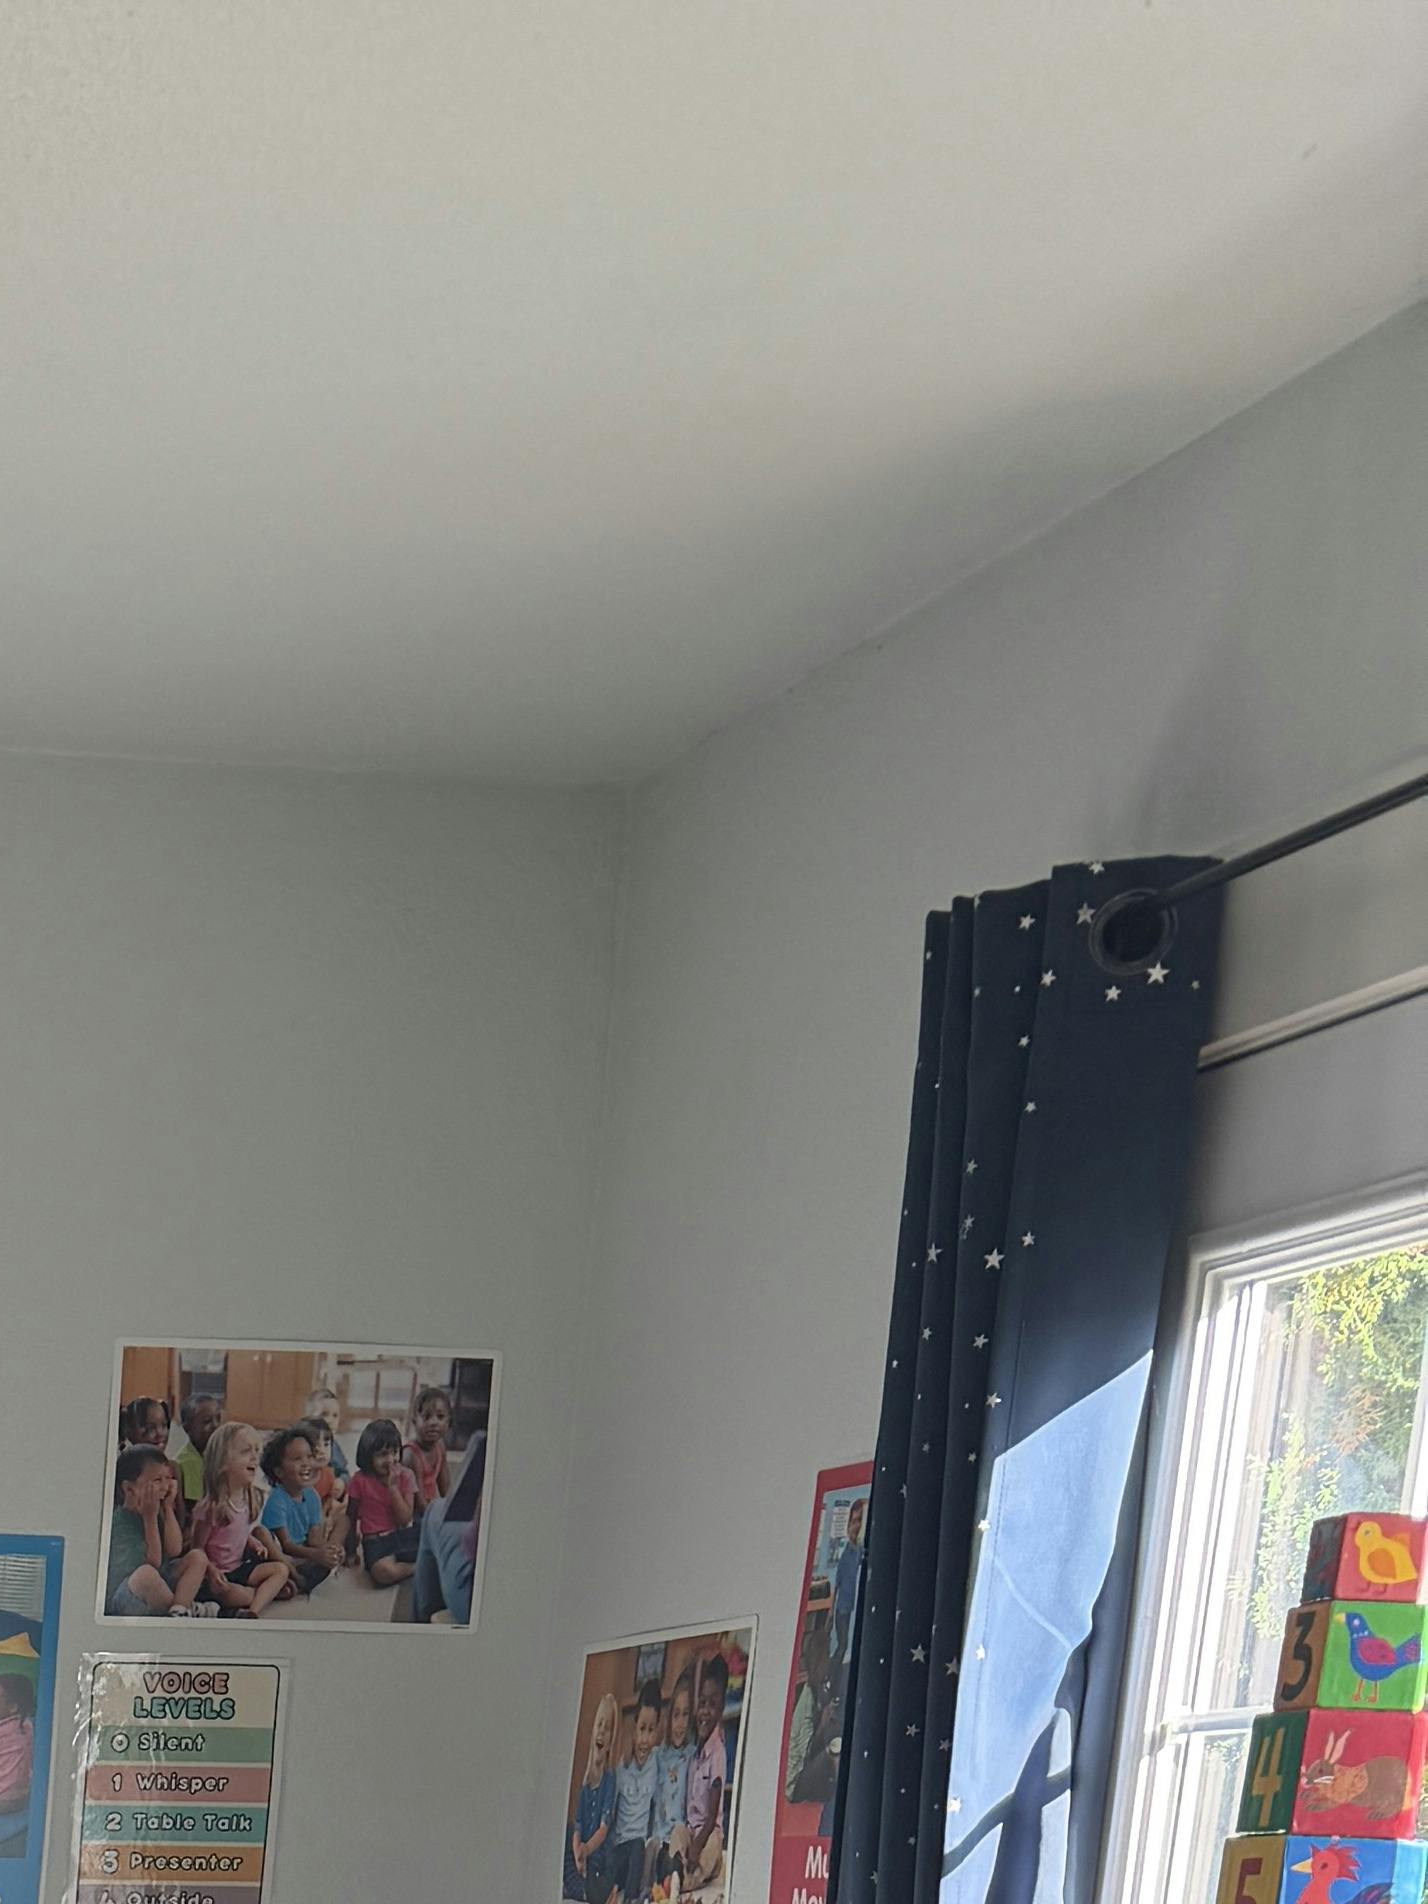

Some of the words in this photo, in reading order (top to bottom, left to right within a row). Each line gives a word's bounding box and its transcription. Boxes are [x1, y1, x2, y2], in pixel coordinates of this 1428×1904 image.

[1281, 1612, 1315, 1700] 3
[143, 1671, 230, 1695] VOICE
[133, 1696, 236, 1720] LEVELS
[110, 1733, 130, 1753] 0
[137, 1731, 205, 1753] Silent
[111, 1773, 123, 1792] 1
[135, 1773, 229, 1795] Whisper
[1252, 1729, 1284, 1828] 4
[105, 1812, 122, 1832] 2
[133, 1813, 196, 1832] Table
[203, 1813, 253, 1832] Talk
[129, 1852, 244, 1872] Presenter
